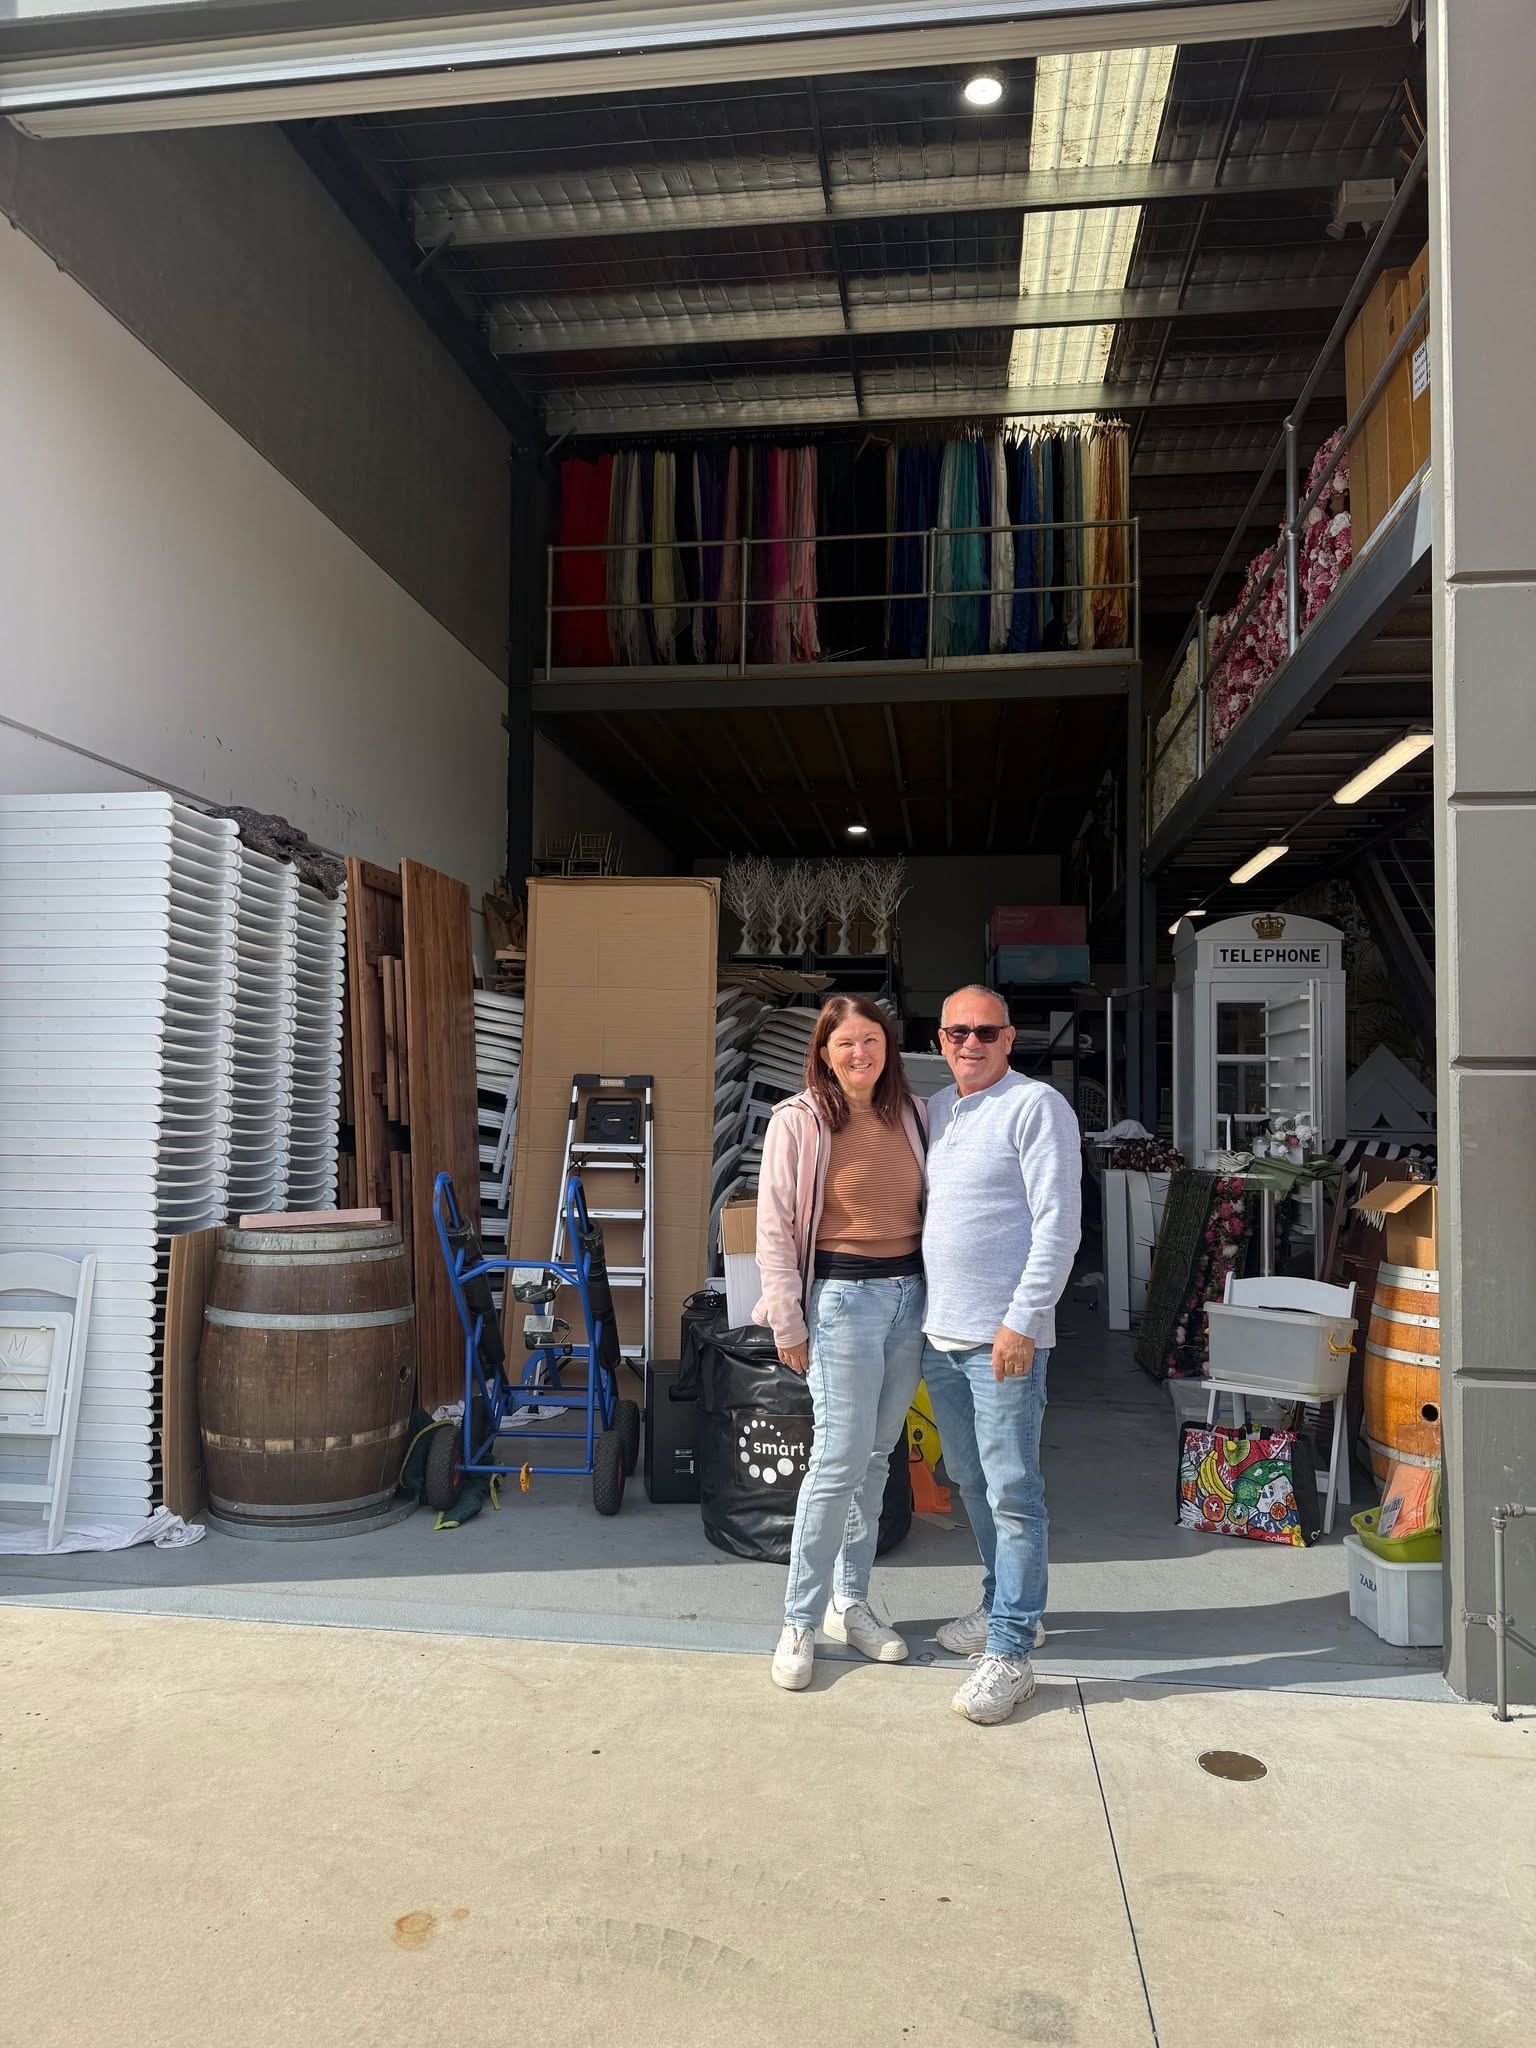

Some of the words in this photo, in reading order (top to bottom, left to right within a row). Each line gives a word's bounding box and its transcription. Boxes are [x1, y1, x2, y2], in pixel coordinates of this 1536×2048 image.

[1219, 948, 1321, 963] TELEPHONE
[753, 1441, 805, 1457] smart
[1264, 1535, 1291, 1544] coles
